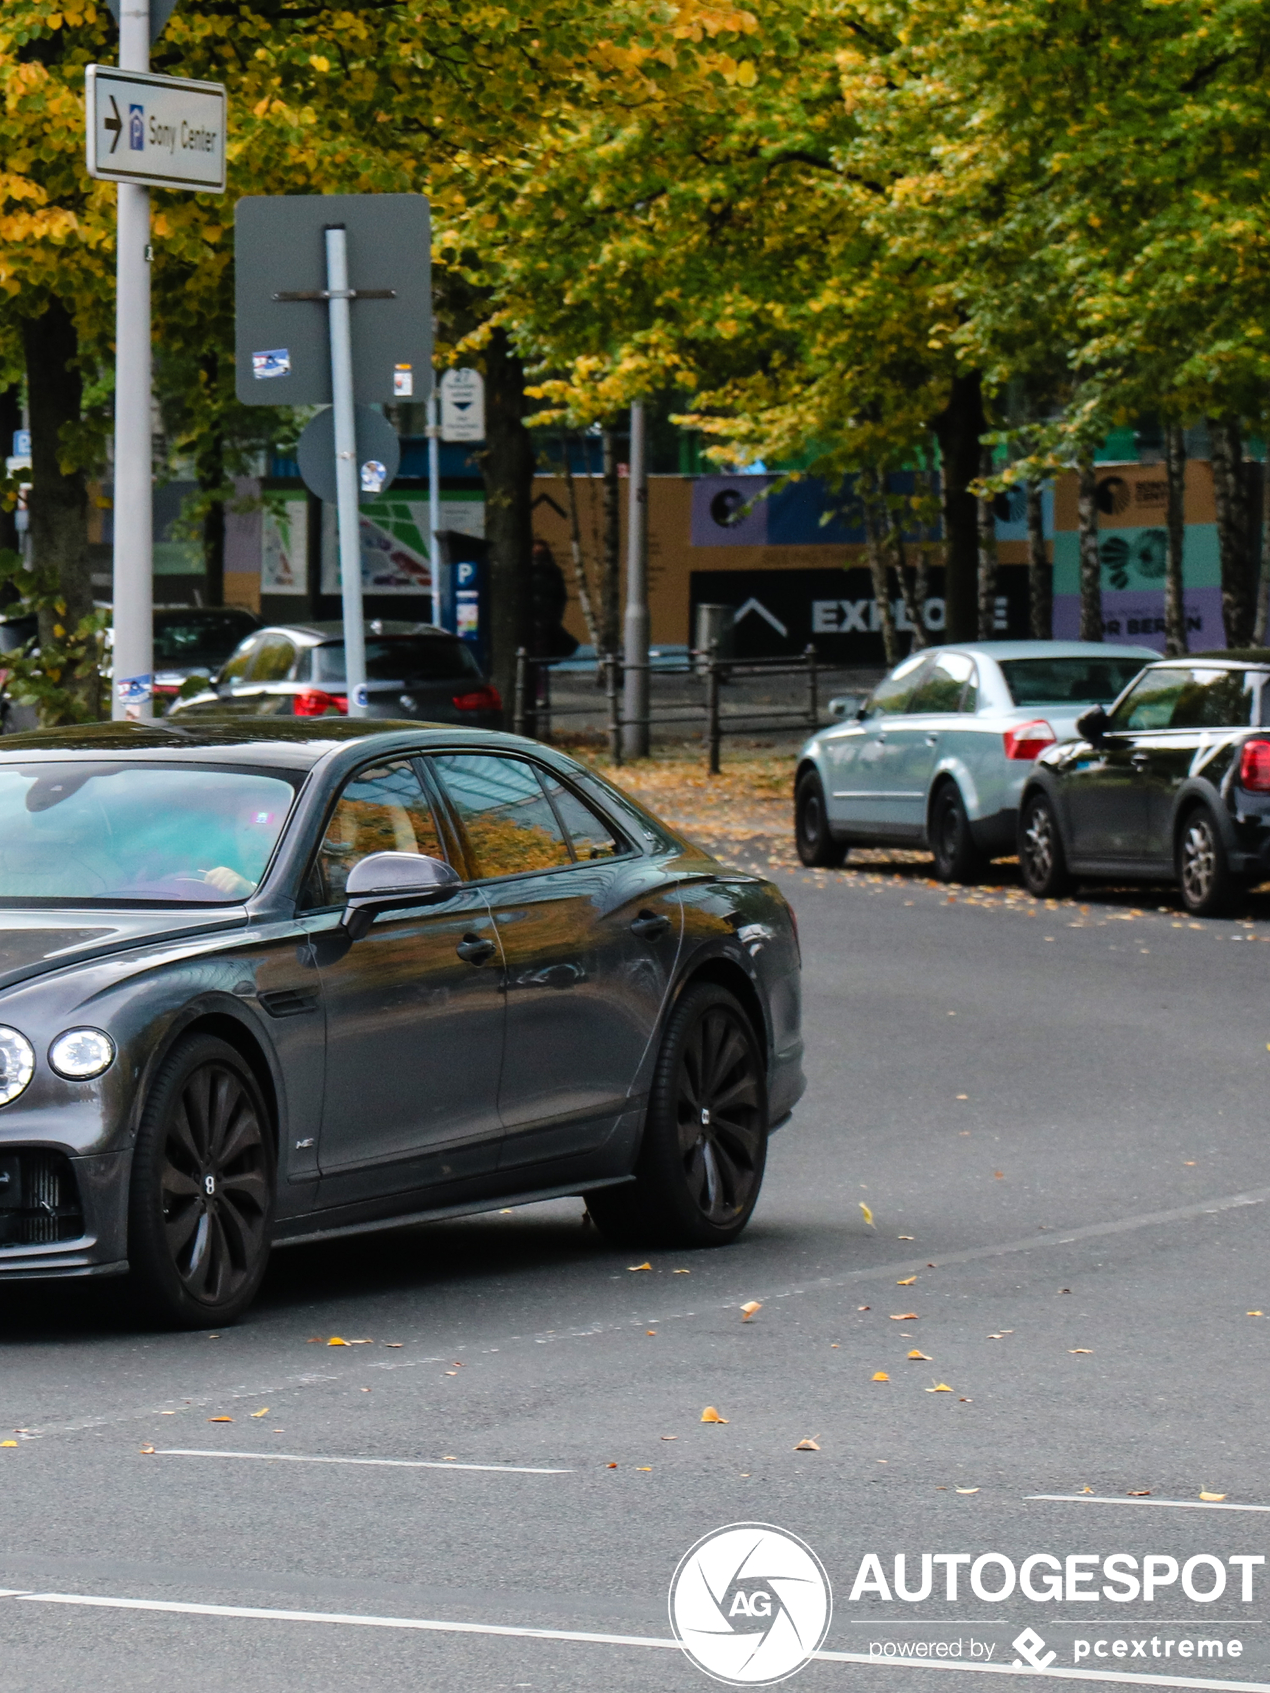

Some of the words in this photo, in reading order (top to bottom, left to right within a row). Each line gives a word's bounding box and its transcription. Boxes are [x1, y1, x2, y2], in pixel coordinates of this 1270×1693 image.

[149, 115, 176, 155] Sony
[181, 119, 216, 153] Center
[457, 562, 473, 584] P
[812, 597, 1008, 633] EXPLOE
